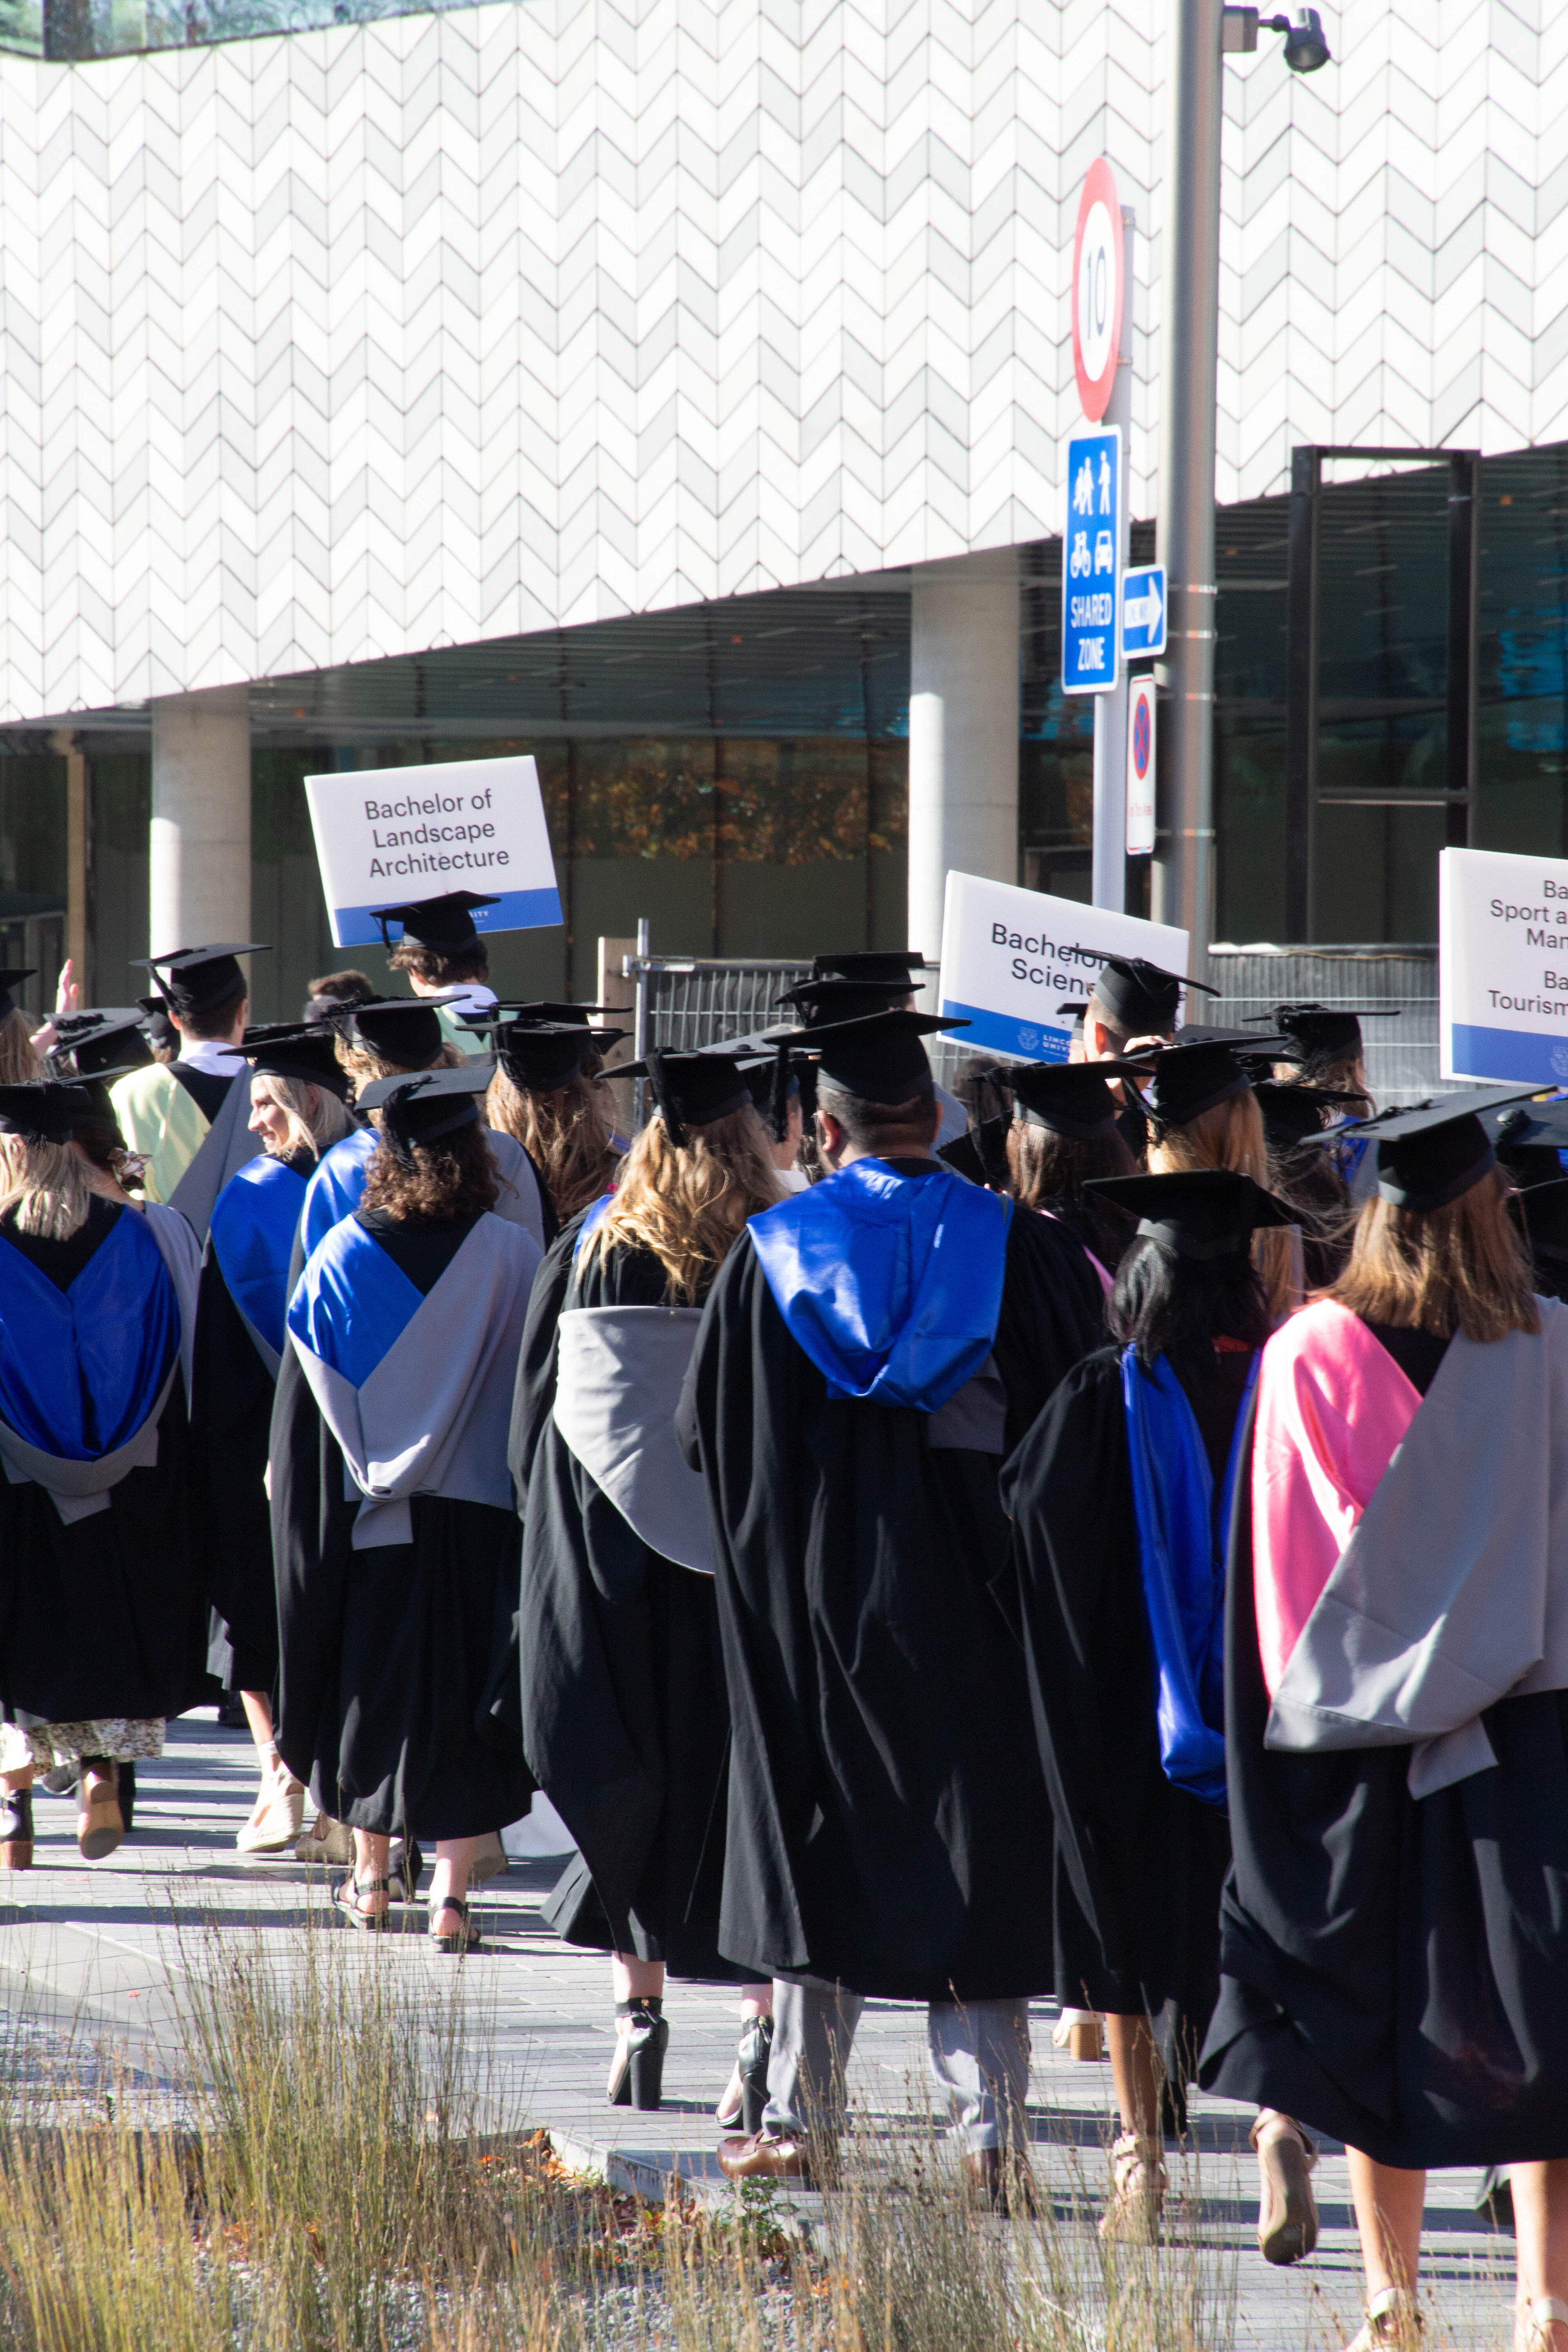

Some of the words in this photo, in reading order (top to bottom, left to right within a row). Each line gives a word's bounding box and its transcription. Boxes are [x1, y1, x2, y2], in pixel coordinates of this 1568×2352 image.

[1087, 245, 1106, 340] 10
[1071, 593, 1112, 628] SHARED
[1078, 636, 1105, 671] ZONE
[365, 793, 464, 820] Bachelor
[471, 788, 492, 810] of
[372, 822, 495, 848] Landscape
[369, 850, 510, 878] Architecture
[1490, 899, 1550, 922] Sport
[1488, 989, 1568, 1016] Tourism
